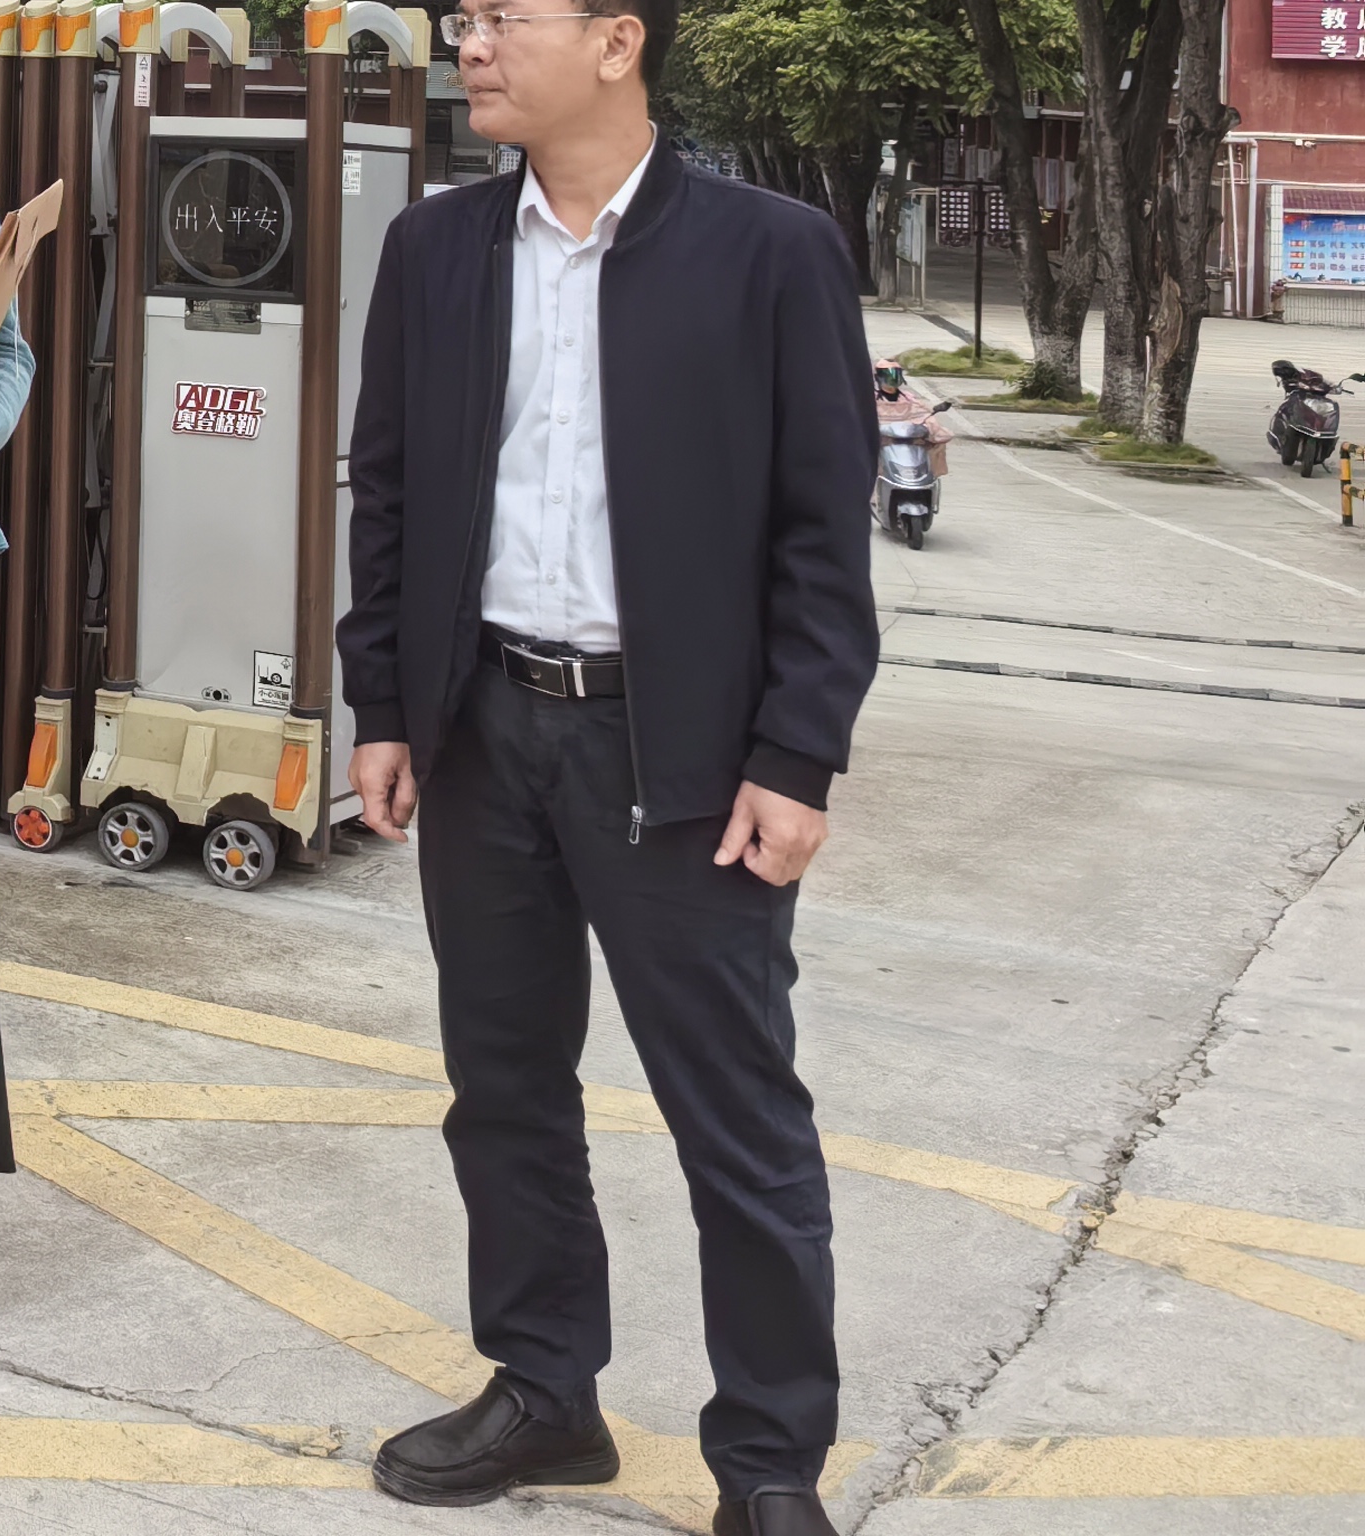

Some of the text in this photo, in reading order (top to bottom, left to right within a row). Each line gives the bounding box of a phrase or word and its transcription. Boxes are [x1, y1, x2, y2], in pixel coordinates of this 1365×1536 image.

[175, 203, 278, 236] 出入平安
[177, 383, 261, 414] ADGL
[175, 408, 257, 436] 奥登格勒
